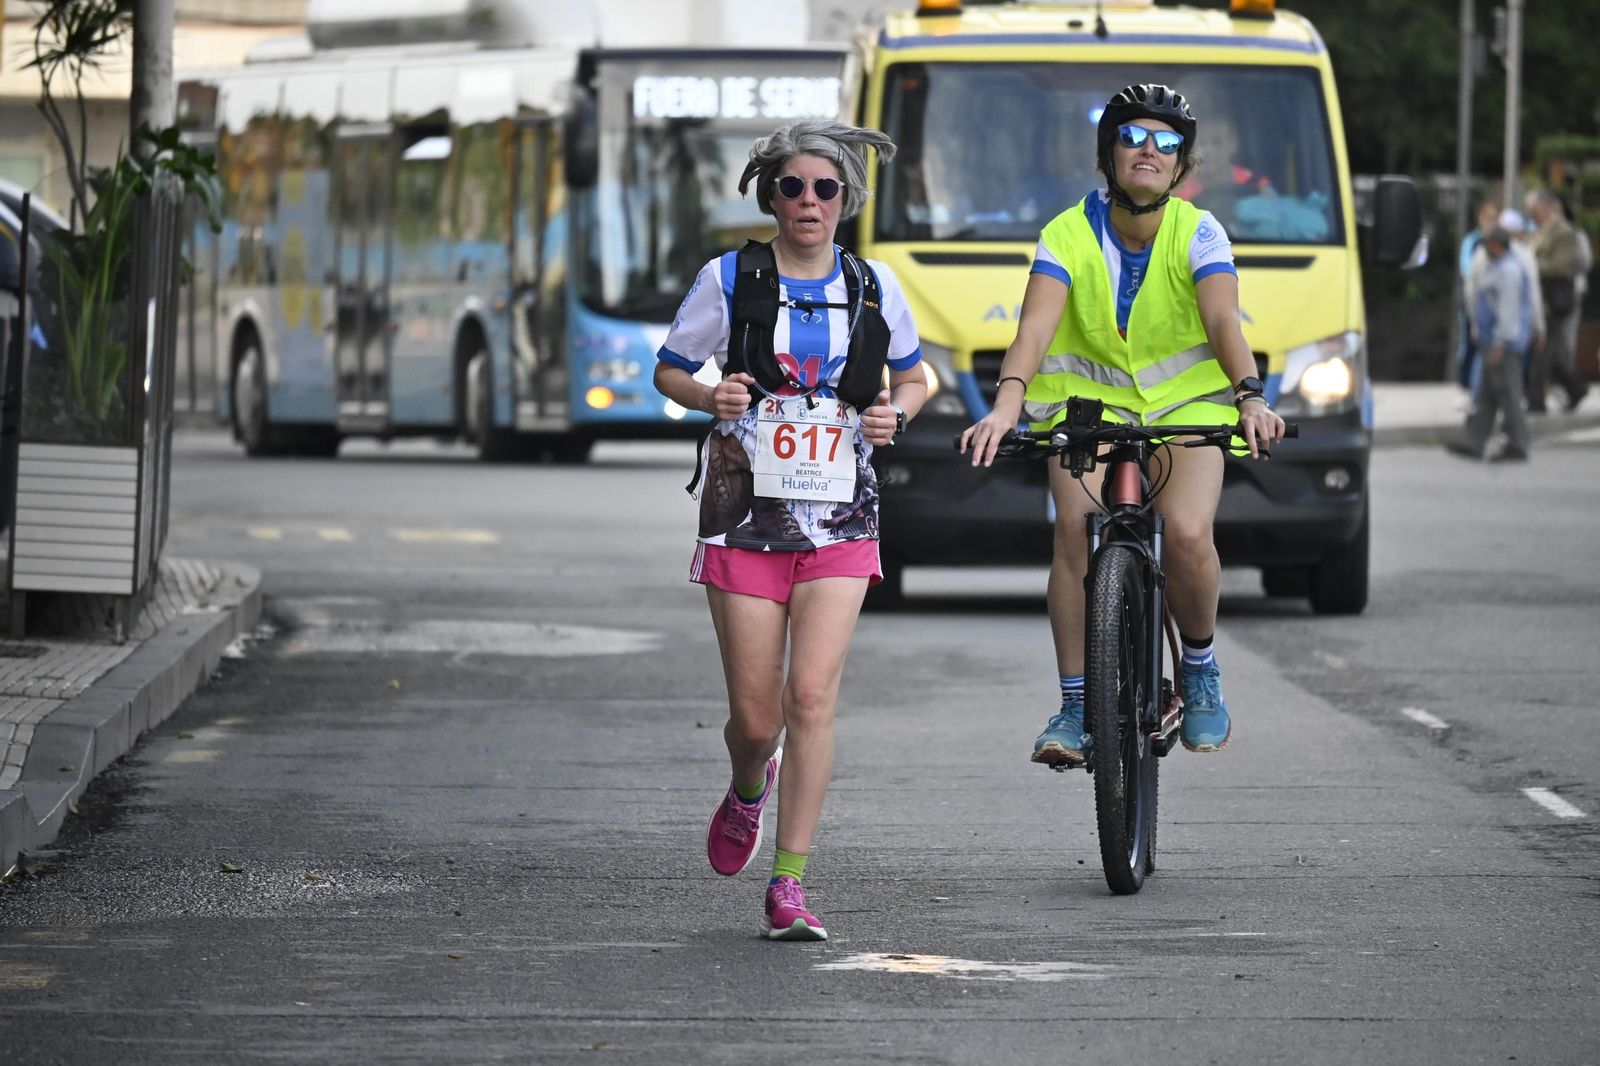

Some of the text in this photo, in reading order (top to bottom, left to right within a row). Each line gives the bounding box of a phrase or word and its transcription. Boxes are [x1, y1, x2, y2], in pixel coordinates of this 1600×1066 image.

[633, 76, 719, 118] FUERA
[720, 76, 759, 118] DE
[773, 423, 843, 462] 617
[781, 477, 828, 491] Huelva
[795, 469, 823, 477] BEATRICE
